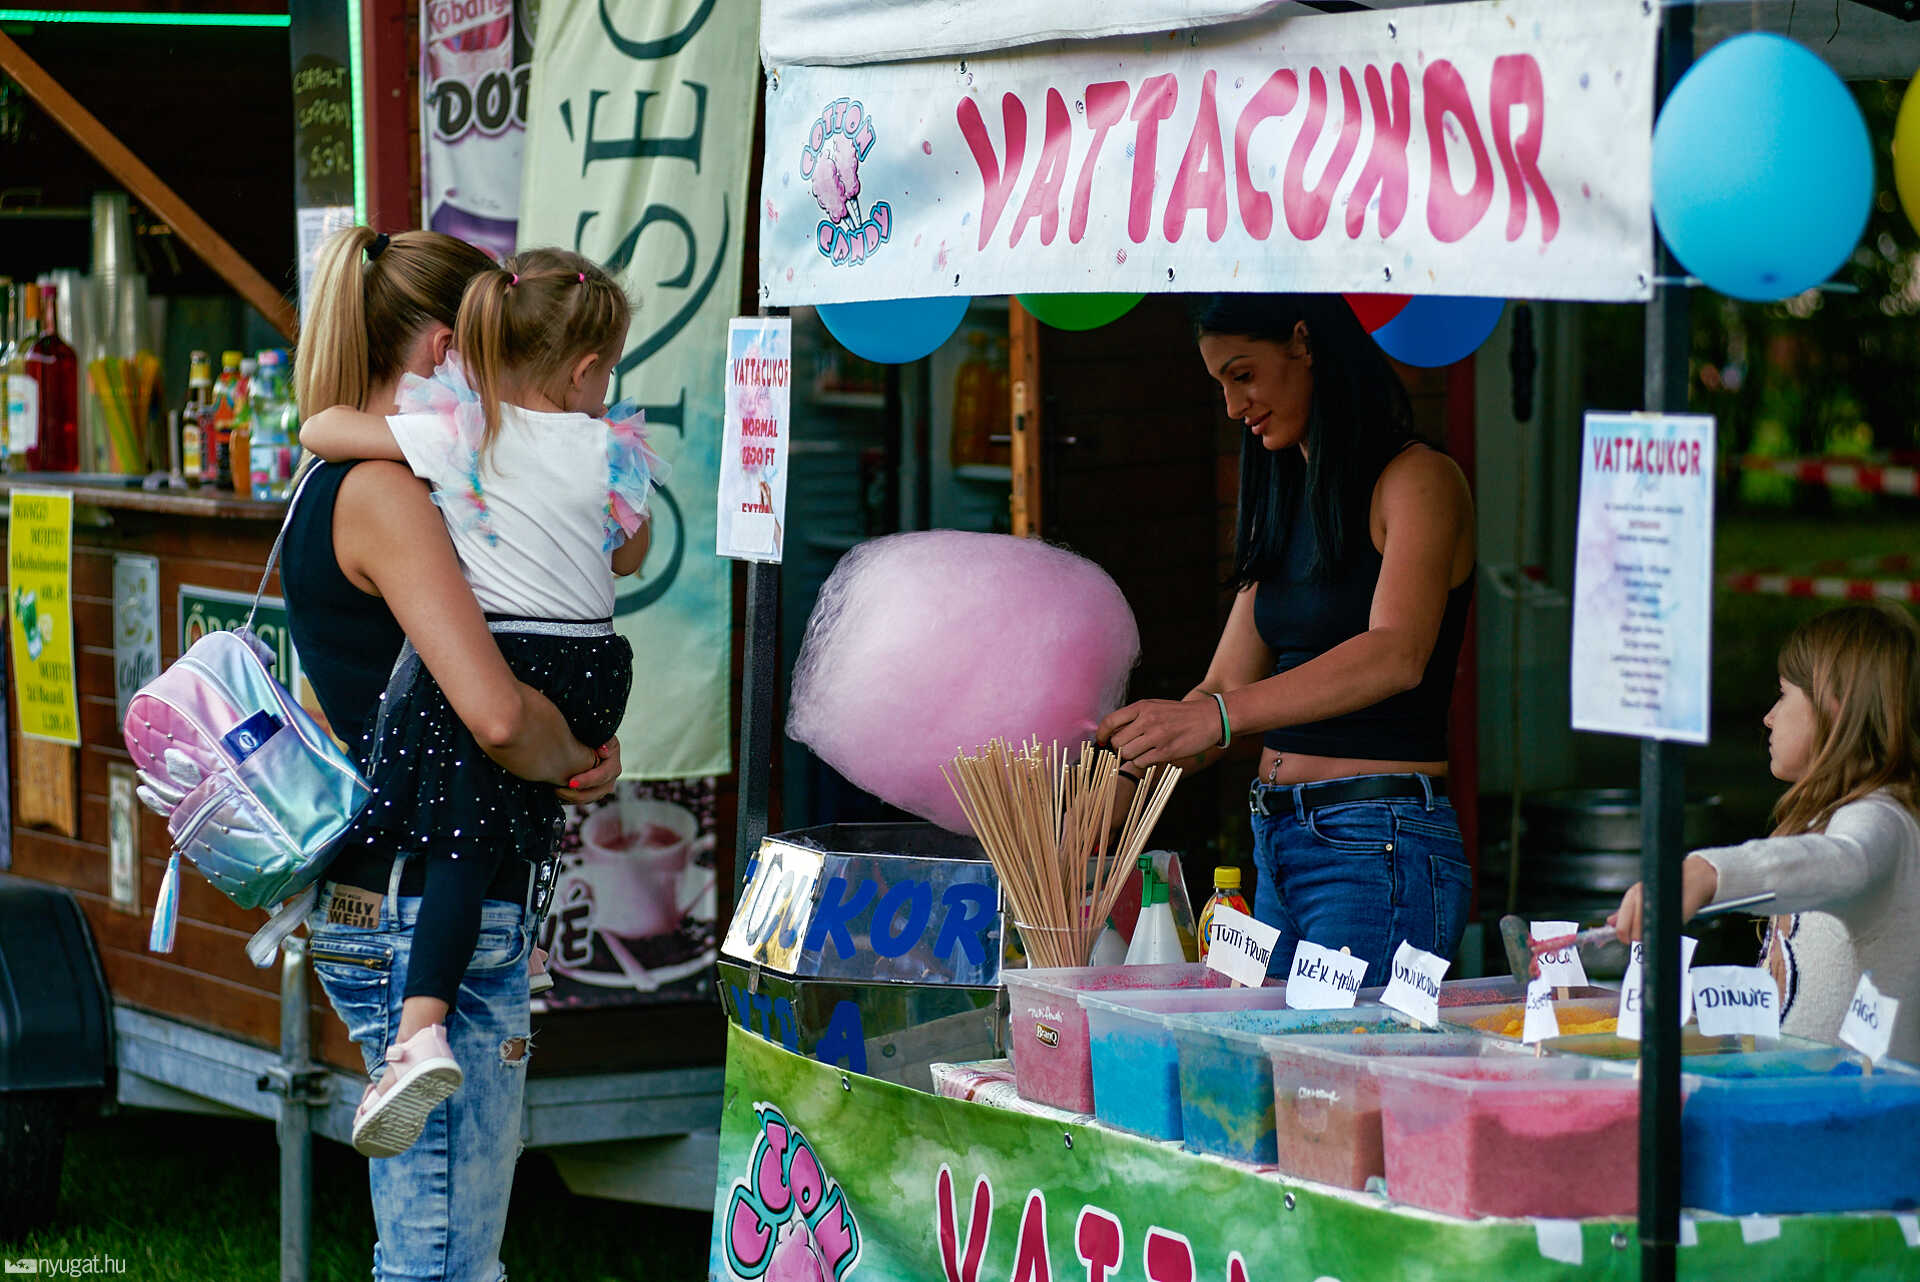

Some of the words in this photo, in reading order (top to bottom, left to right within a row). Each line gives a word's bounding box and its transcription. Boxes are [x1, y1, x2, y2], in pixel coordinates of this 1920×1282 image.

[800, 97, 877, 181] COTTON
[956, 52, 1560, 253] VATTACUKOR
[816, 200, 893, 269] CANDY
[741, 414, 778, 438] NORMÁL
[765, 447, 776, 467] FT
[1592, 436, 1701, 476] VATTACUKOR
[331, 896, 375, 915] TALLY
[1296, 957, 1329, 984] KÉK
[1036, 1024, 1058, 1045] BranQ
